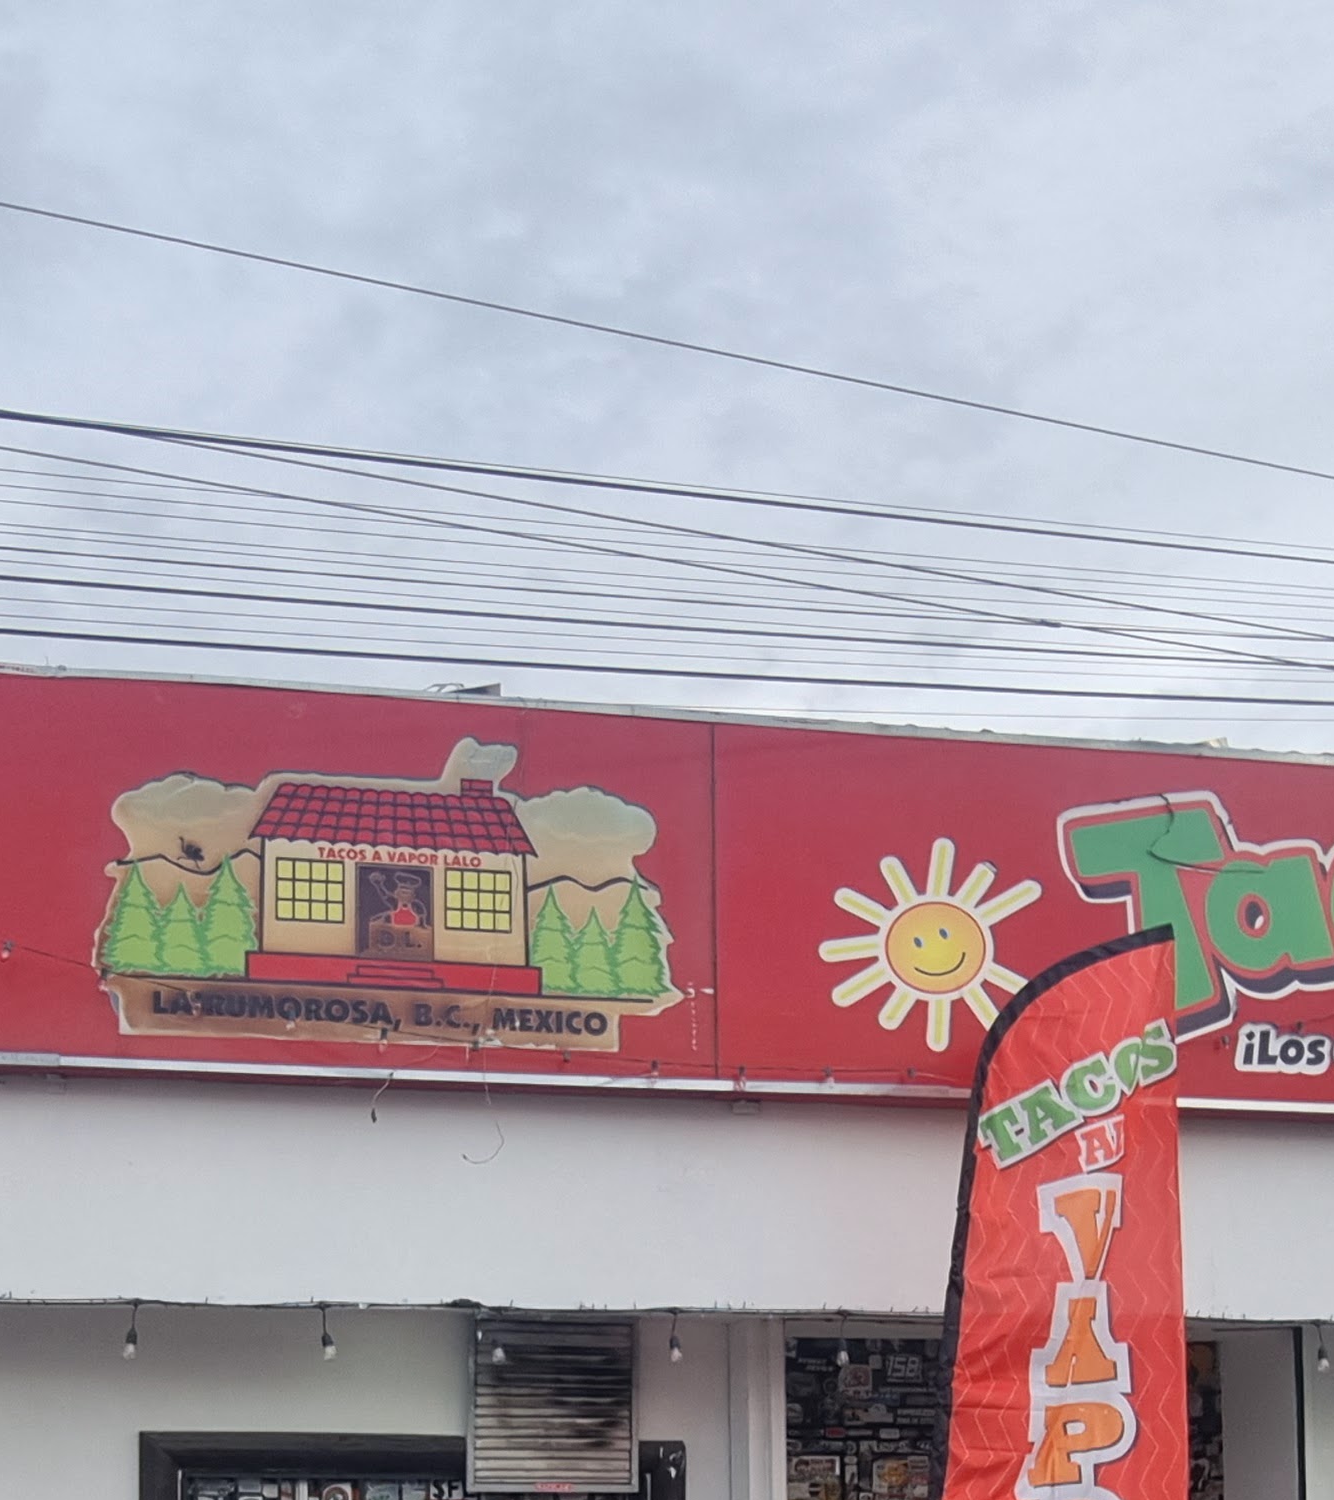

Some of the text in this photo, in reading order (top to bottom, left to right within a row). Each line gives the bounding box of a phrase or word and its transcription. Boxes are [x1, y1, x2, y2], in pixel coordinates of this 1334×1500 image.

[318, 846, 482, 868] TACOS A VAPOR LALO
[152, 990, 195, 1017] LA
[492, 1006, 609, 1037] MEXICO
[979, 1021, 1176, 1166] TACOS
